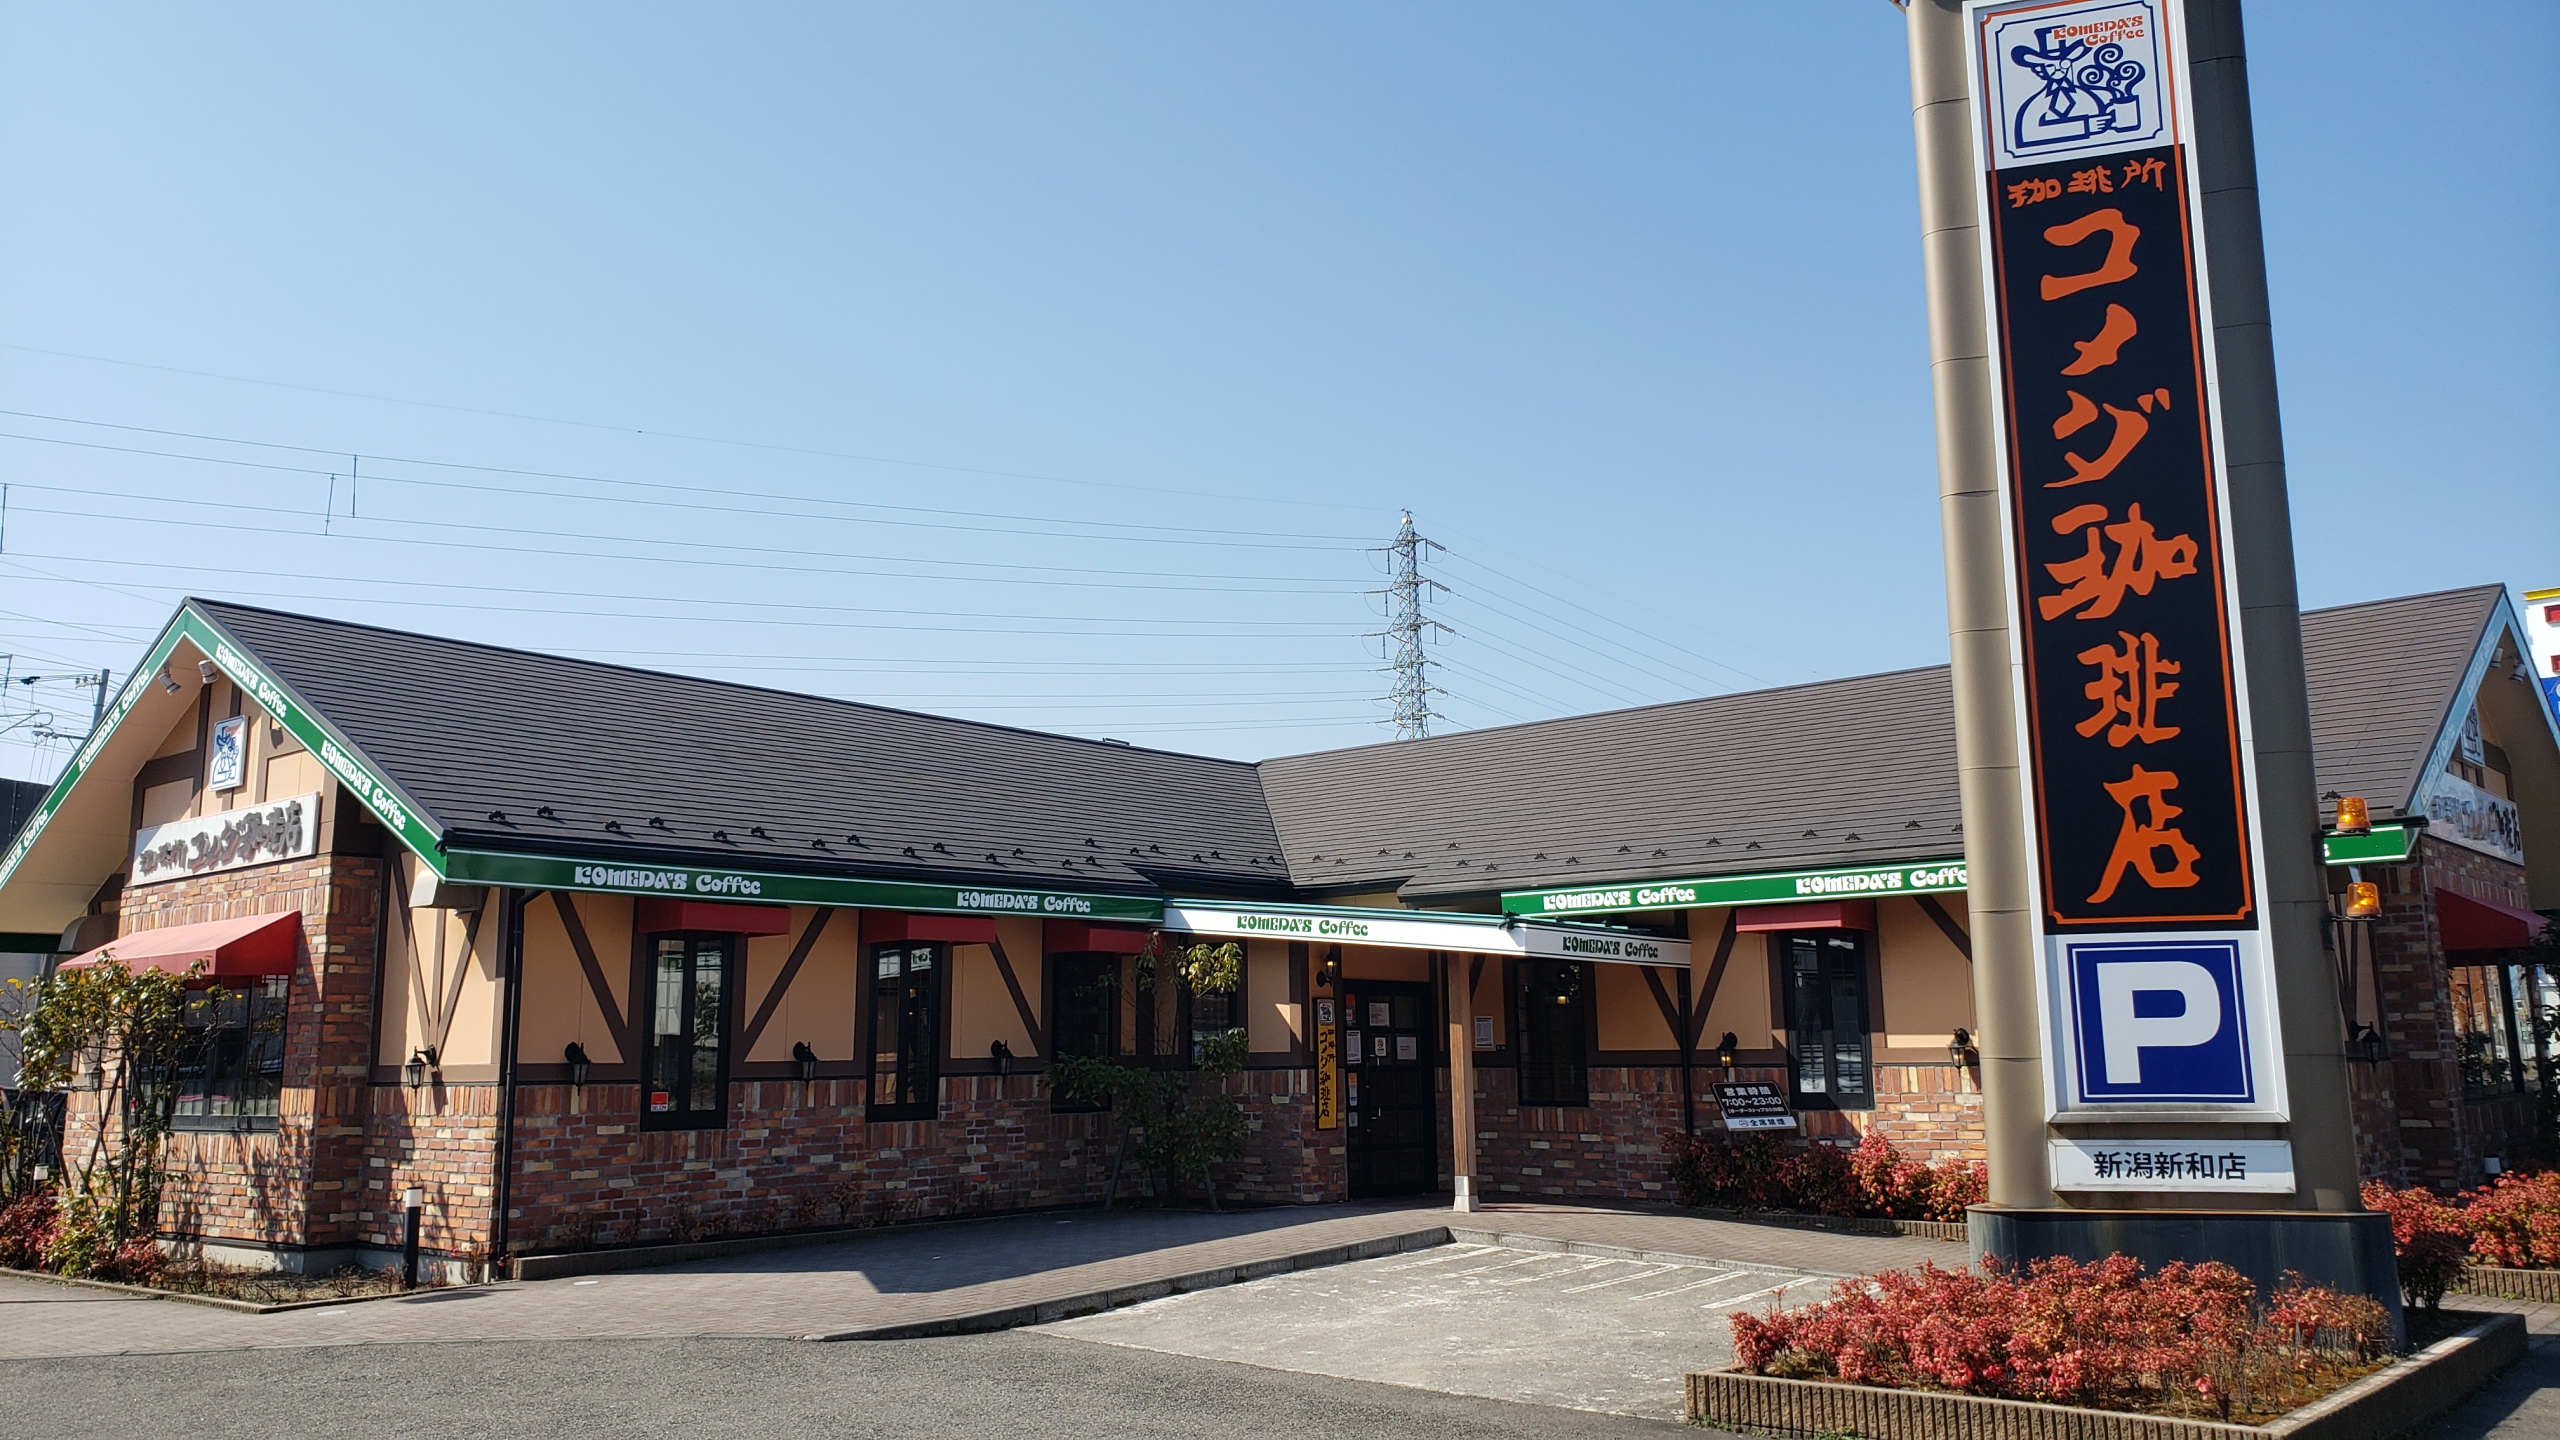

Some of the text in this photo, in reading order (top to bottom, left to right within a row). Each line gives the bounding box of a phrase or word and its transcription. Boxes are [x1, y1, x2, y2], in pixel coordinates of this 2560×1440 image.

[2053, 15, 2144, 40] KOMEDA'S
[2085, 28, 2145, 47] Coffee
[2037, 207, 2202, 904] コメダ珈琲店
[121, 668, 150, 711] Coffee
[215, 642, 287, 718] KOMEDA'S Coffee
[320, 739, 407, 831] KOMEDA'S Coffee
[574, 866, 762, 895] KOMEDA'S Coffee
[1795, 867, 1968, 894] KOMEDA'S Coffe
[957, 891, 1092, 913] KOMEDA'S Coffee
[1542, 886, 1697, 911] KOMEDA'S Coffee
[1236, 915, 1369, 936] KOMEDA'S Coffee
[1562, 936, 1659, 959] KOMEDA'S Coffee
[2096, 961, 2221, 1084] P
[1724, 1087, 1771, 1096] 営業時間
[2093, 1151, 2246, 1181] 新潟新和店
